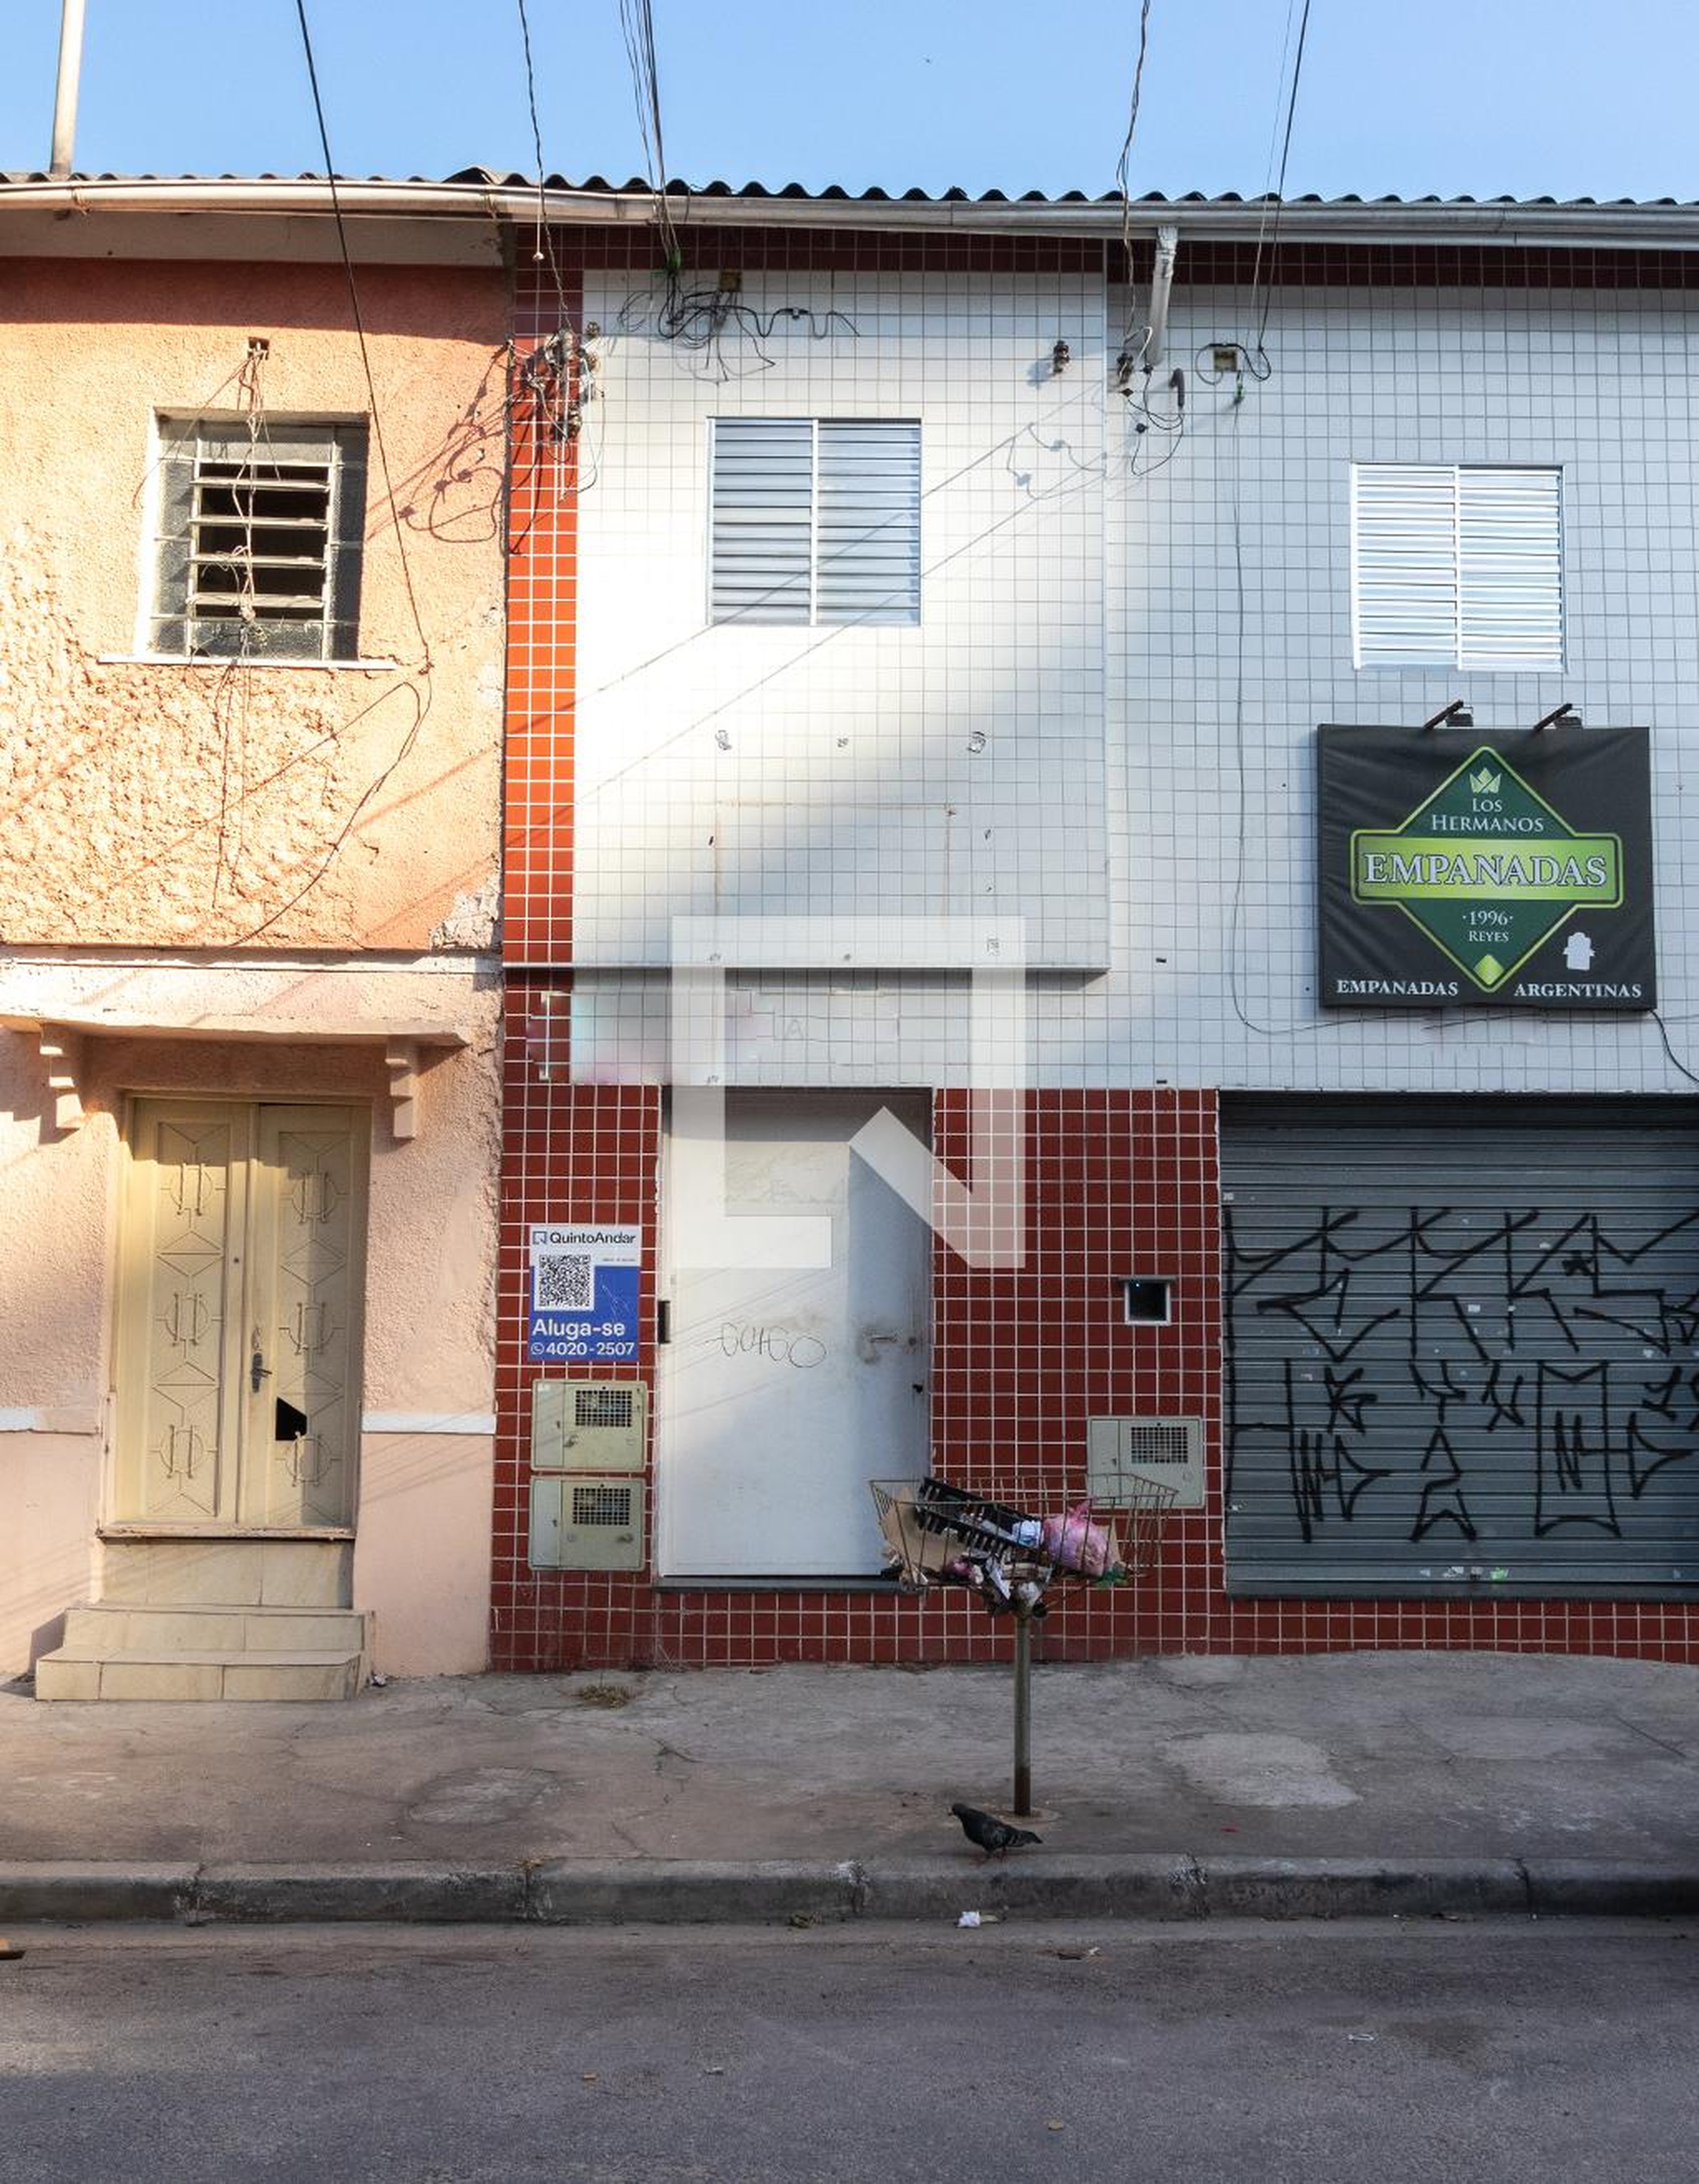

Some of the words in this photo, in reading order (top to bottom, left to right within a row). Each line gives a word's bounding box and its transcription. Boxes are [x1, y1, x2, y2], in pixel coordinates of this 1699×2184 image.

[1431, 814, 1544, 832] HERMANOS
[1364, 852, 1608, 887] EMPANADAS
[1468, 930, 1509, 943] REYES
[1337, 979, 1458, 996] EMPANADAS
[1514, 983, 1642, 998] ARGENTINAS
[532, 1318, 626, 1340] Aluga-se
[546, 1342, 635, 1355] 4020-2507
